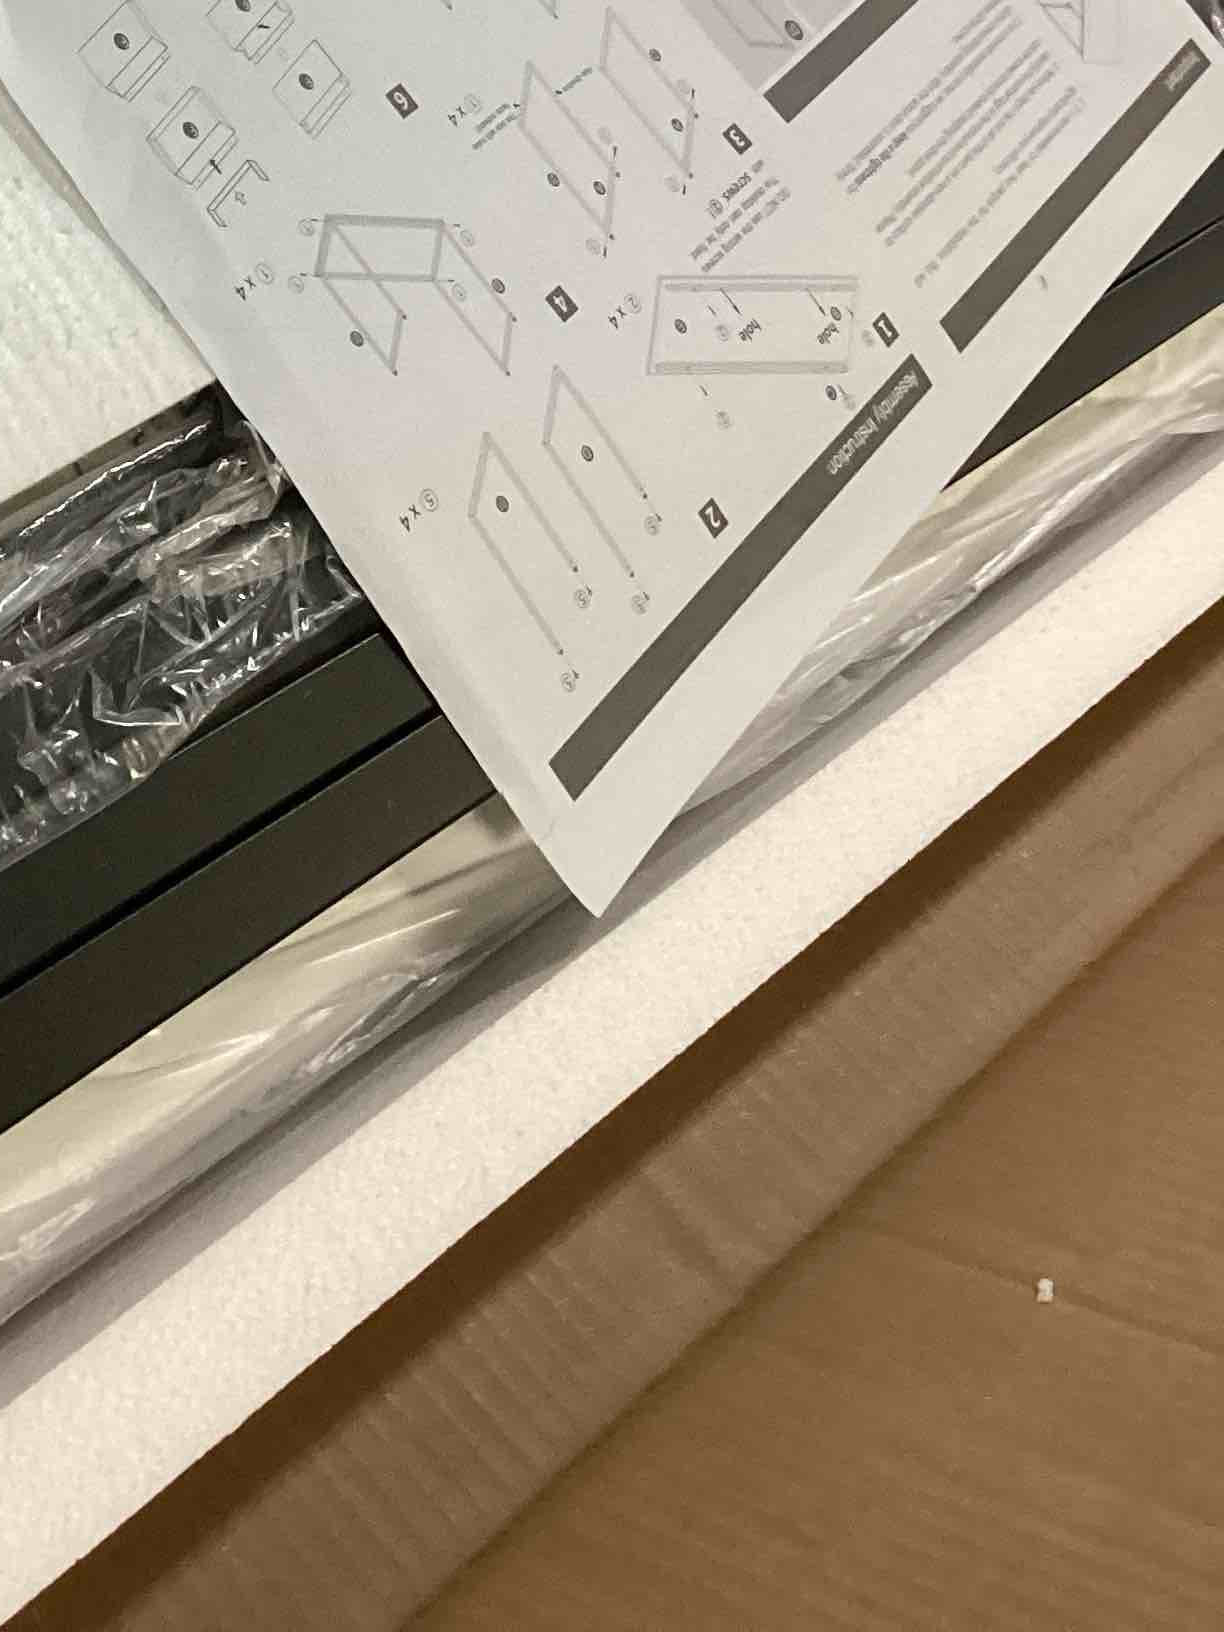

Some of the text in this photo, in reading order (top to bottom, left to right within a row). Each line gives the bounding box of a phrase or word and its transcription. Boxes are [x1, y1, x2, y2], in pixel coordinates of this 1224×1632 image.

[738, 318, 762, 342] hole
[817, 322, 840, 344] hole
[872, 369, 921, 427] Assembly
